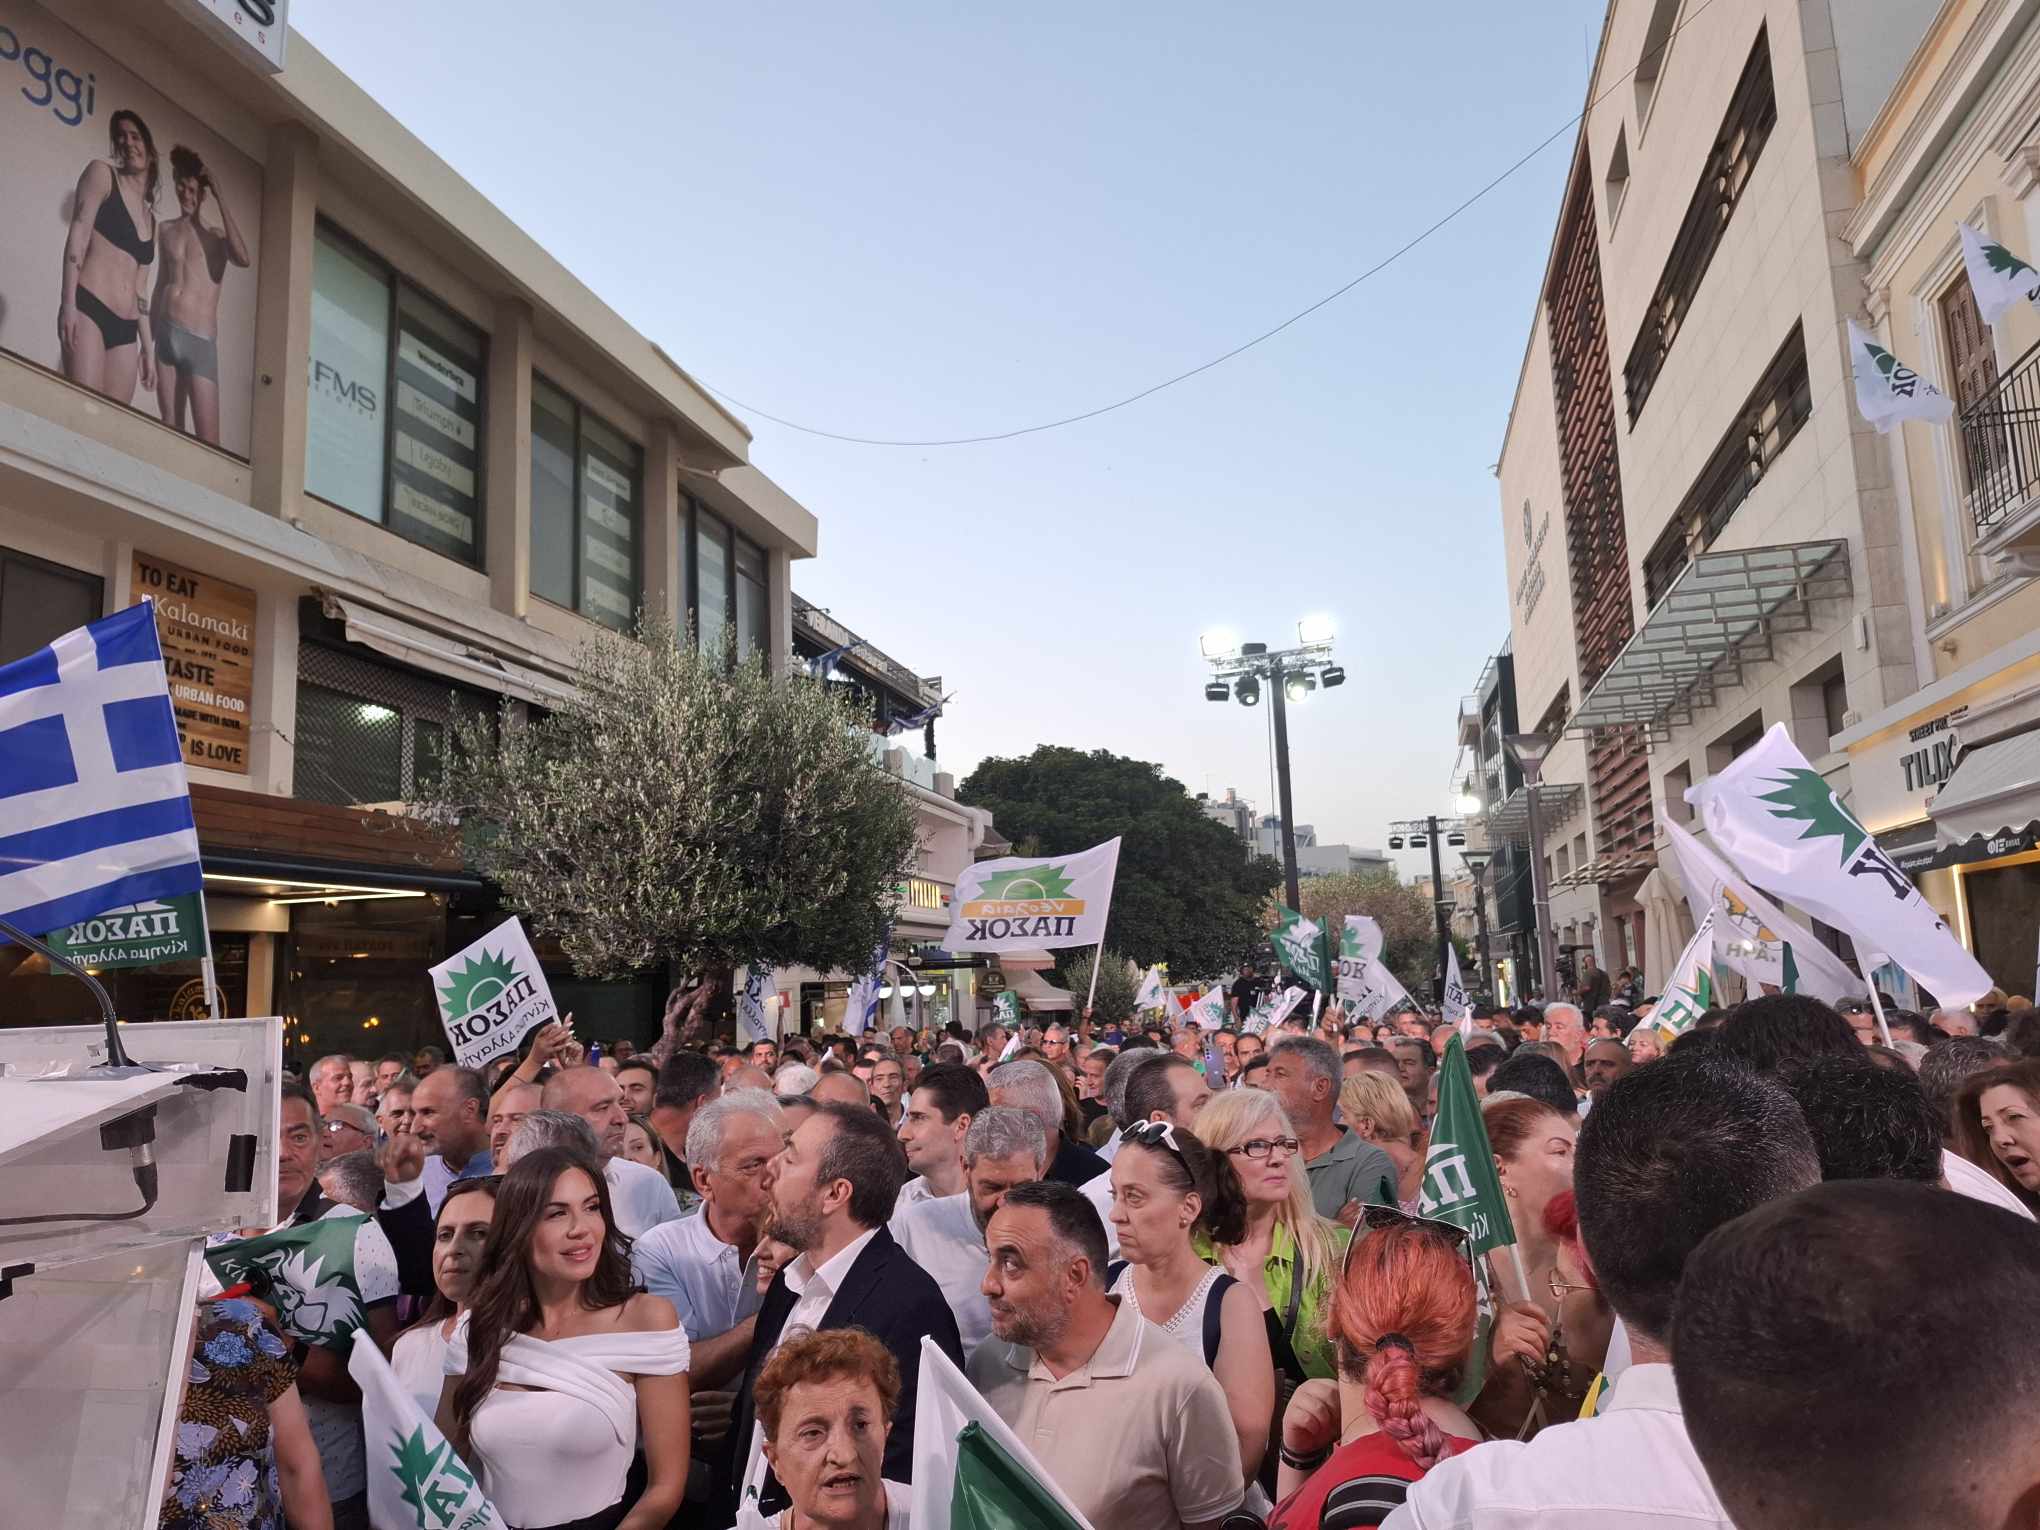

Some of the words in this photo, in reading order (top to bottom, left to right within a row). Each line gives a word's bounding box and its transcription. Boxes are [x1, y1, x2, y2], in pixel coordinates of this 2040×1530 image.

[139, 563, 161, 587] TO
[166, 574, 199, 599] EAT
[153, 597, 249, 641] Kalamaki
[167, 626, 210, 647] URBAN
[215, 637, 249, 657] FOOD
[165, 656, 215, 686] TASTE
[175, 684, 214, 706] URBAN
[216, 691, 245, 713] FOOD
[190, 738, 204, 756] IS
[207, 740, 242, 764] LOVE
